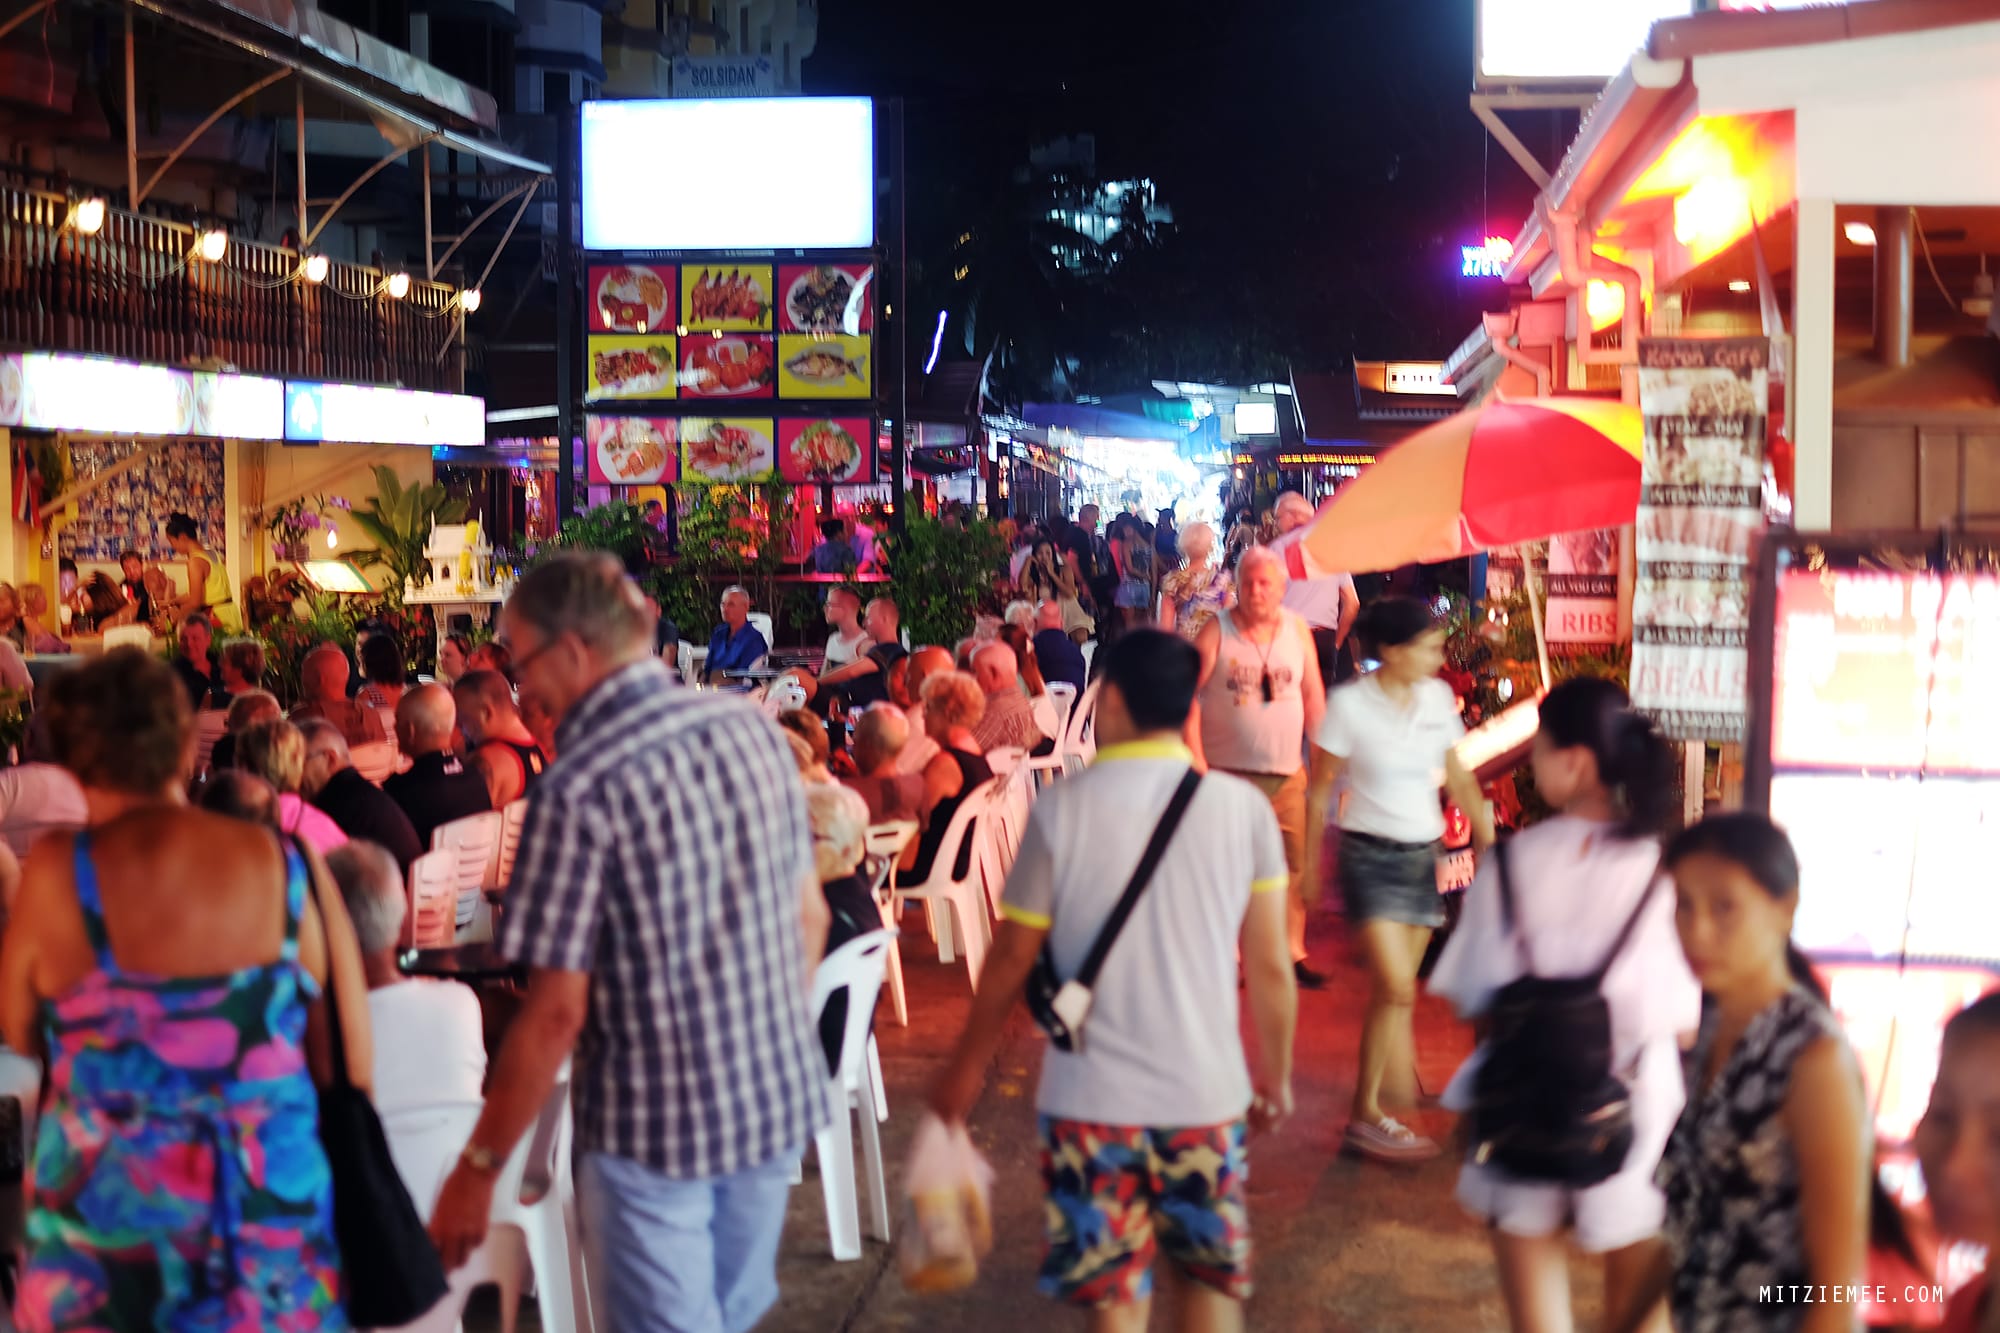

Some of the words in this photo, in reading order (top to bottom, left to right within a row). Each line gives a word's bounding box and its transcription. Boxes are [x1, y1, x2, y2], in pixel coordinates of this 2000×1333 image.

[691, 65, 755, 87] SOLSIDAN
[1650, 486, 1750, 505] INTERNATIONAL
[1551, 581, 1566, 593] ALL
[1568, 582, 1589, 593] YOU
[1562, 612, 1617, 635] RIBS
[1638, 664, 1747, 699] DEALS
